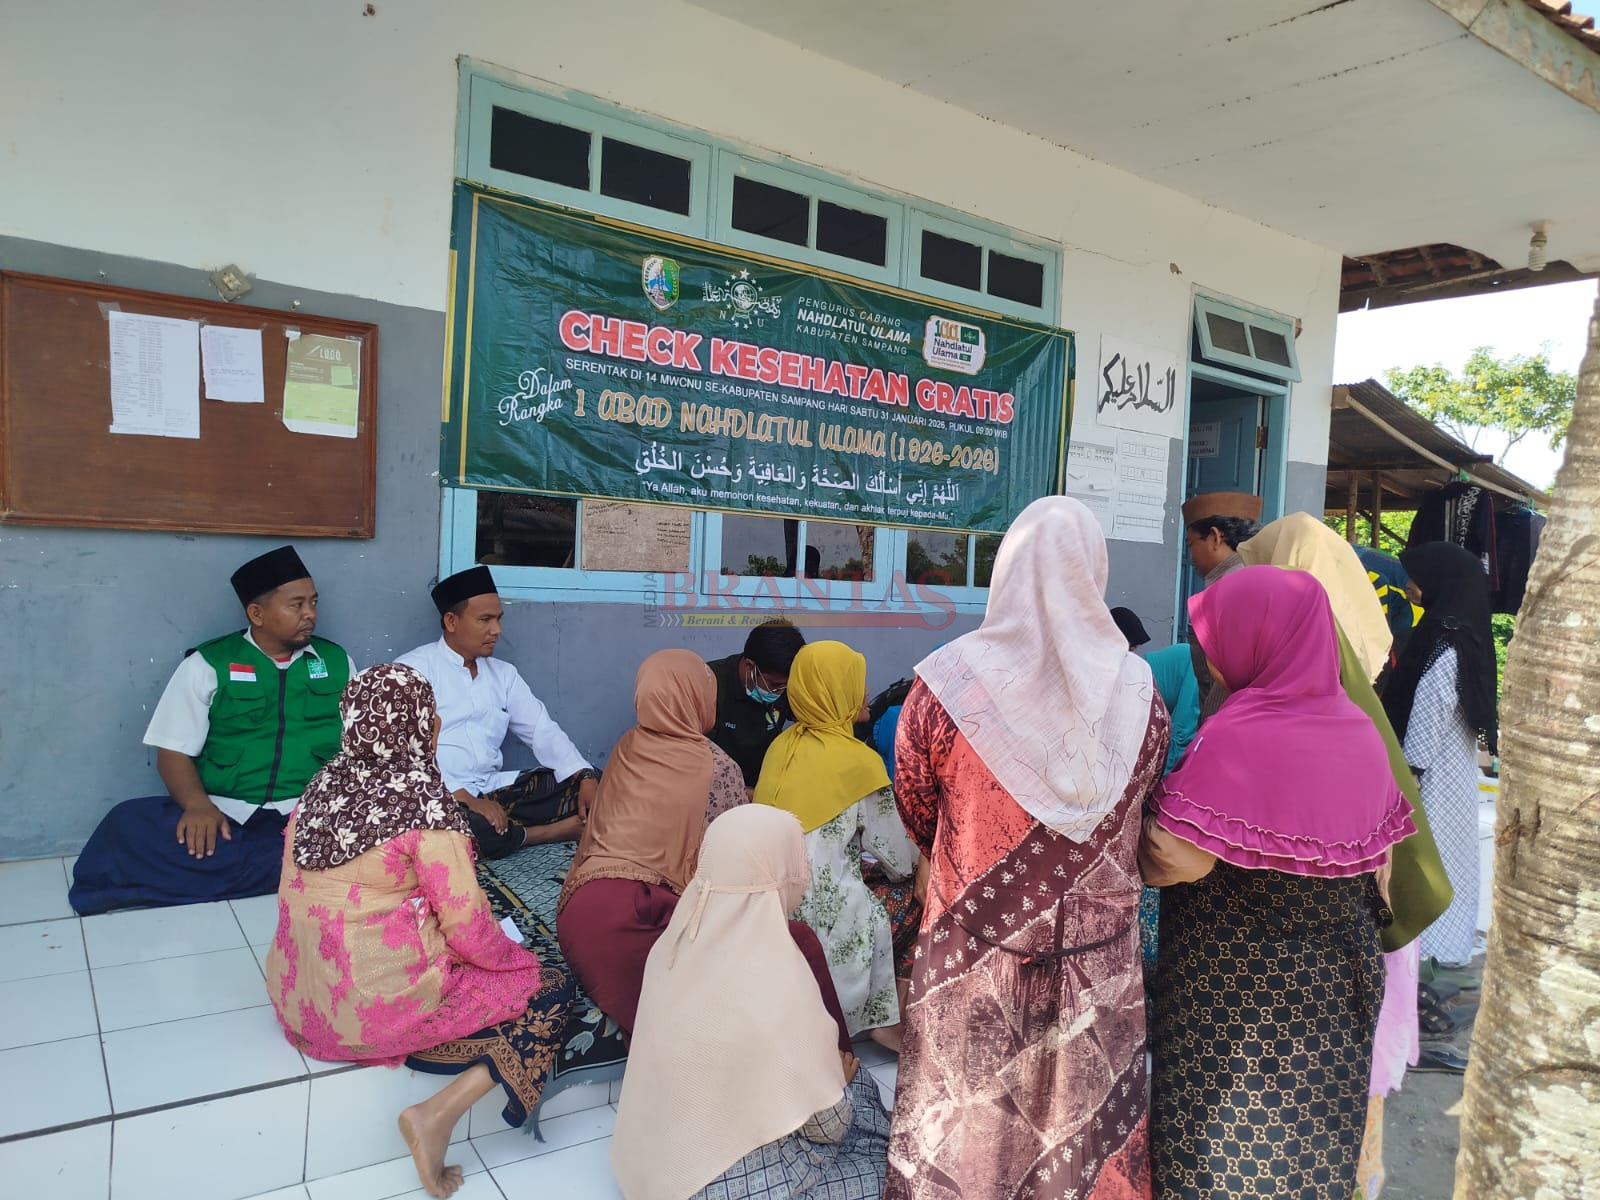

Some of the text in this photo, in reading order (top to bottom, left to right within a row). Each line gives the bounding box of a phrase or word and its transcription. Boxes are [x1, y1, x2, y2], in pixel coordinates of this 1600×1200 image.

[797, 308, 911, 344] NAHDLATUL ULAMA
[798, 296, 901, 327] PENGURUS CABANG
[796, 324, 908, 355] KABUPATEN SAMPANG
[932, 346, 958, 359] Ulama
[933, 338, 973, 353] Nahdlatul
[559, 310, 1015, 424] CHECK KESEHATAN GRATIS
[518, 367, 573, 400] Dalam
[565, 358, 628, 378] SERENTAK
[630, 369, 641, 380] DI
[646, 372, 657, 383] 14
[660, 374, 702, 390] MWCNU
[704, 381, 779, 402] SE-KABUPATEN
[781, 394, 826, 410] SAMPANG
[828, 402, 848, 412] HARI
[850, 406, 879, 419] SABTU
[880, 410, 889, 420] 31
[892, 413, 927, 426] JANUARI
[949, 422, 974, 434] PUKUL
[994, 430, 1008, 439] WIB
[498, 392, 563, 425] Rangka
[574, 389, 586, 417] 1
[691, 486, 708, 497] aku
[711, 488, 754, 501] memohon
[756, 493, 802, 508] kesehatan,
[804, 497, 842, 511] kekuatan,
[844, 501, 859, 512] dan
[861, 503, 885, 515] akhlak
[887, 507, 909, 518] terpuji
